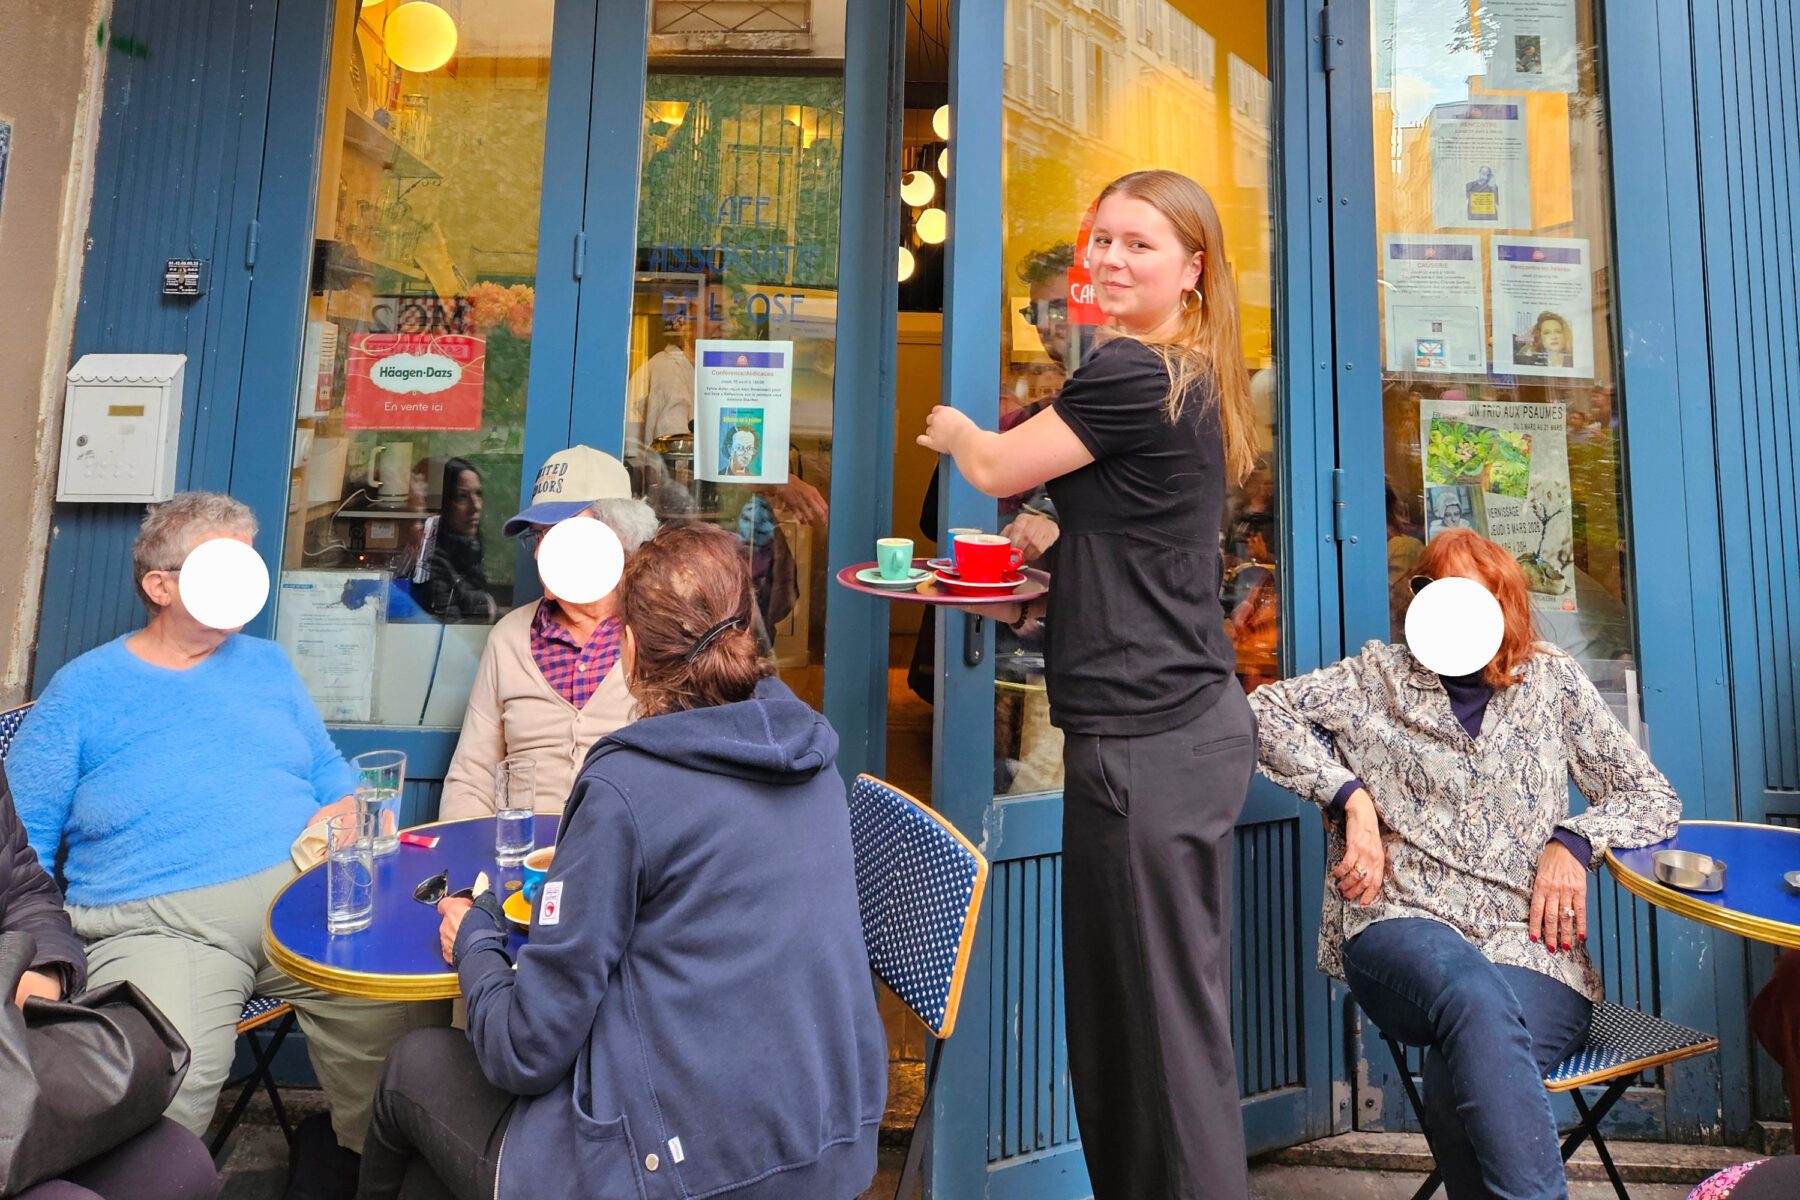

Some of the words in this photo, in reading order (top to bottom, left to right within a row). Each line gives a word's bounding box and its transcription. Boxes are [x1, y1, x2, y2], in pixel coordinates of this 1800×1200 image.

[384, 402, 398, 412] En
[401, 402, 429, 412] vente
[432, 402, 443, 411] ici
[1468, 405, 1480, 417] UN
[1482, 405, 1500, 418] TRIO
[1503, 405, 1521, 418] AUX
[1522, 406, 1563, 420] PSAUMES
[1487, 506, 1520, 519] VERNISSAGE
[1511, 522, 1527, 534] MARS
